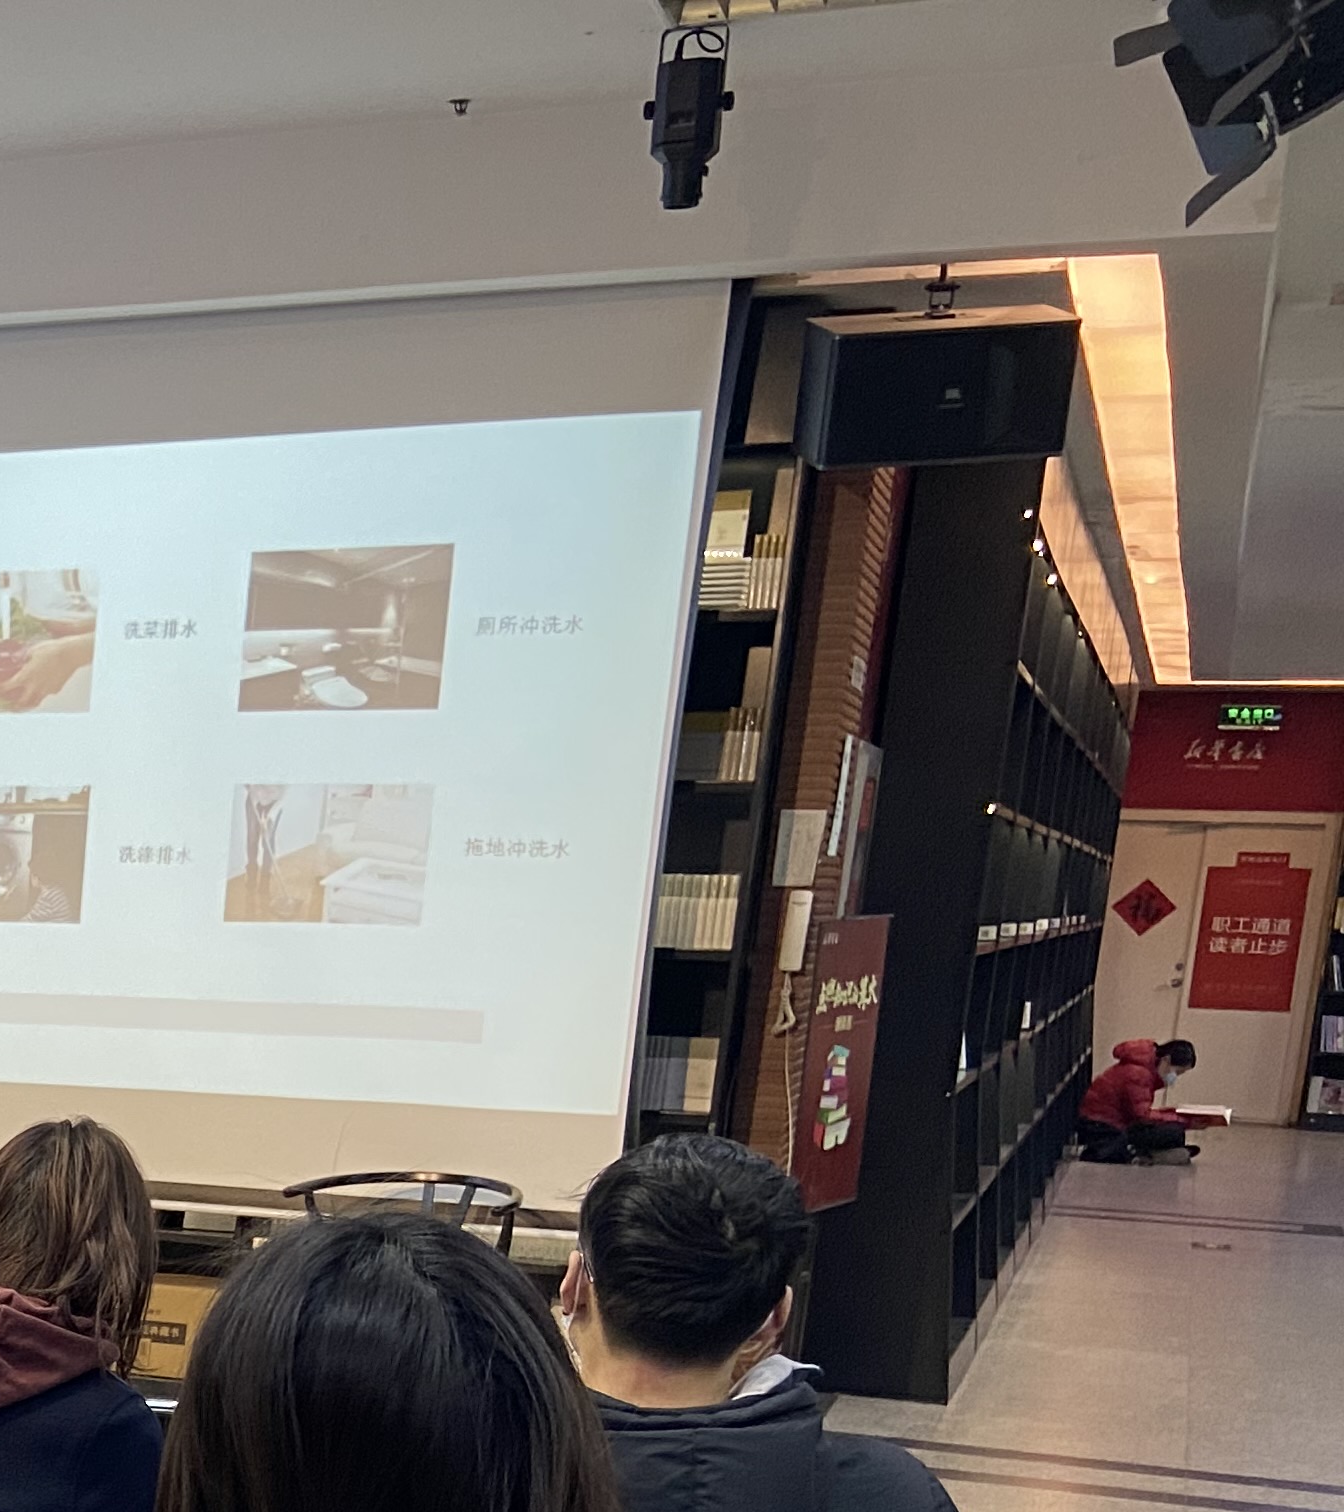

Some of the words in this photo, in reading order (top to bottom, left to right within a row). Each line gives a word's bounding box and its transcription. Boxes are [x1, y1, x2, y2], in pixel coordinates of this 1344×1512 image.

[122, 619, 199, 641] 洗菜排水
[1227, 707, 1275, 720] 安全出口
[463, 836, 572, 861] 拖地冲洗水
[1211, 916, 1292, 936] 职工通道
[1208, 937, 1290, 956] 读者止步
